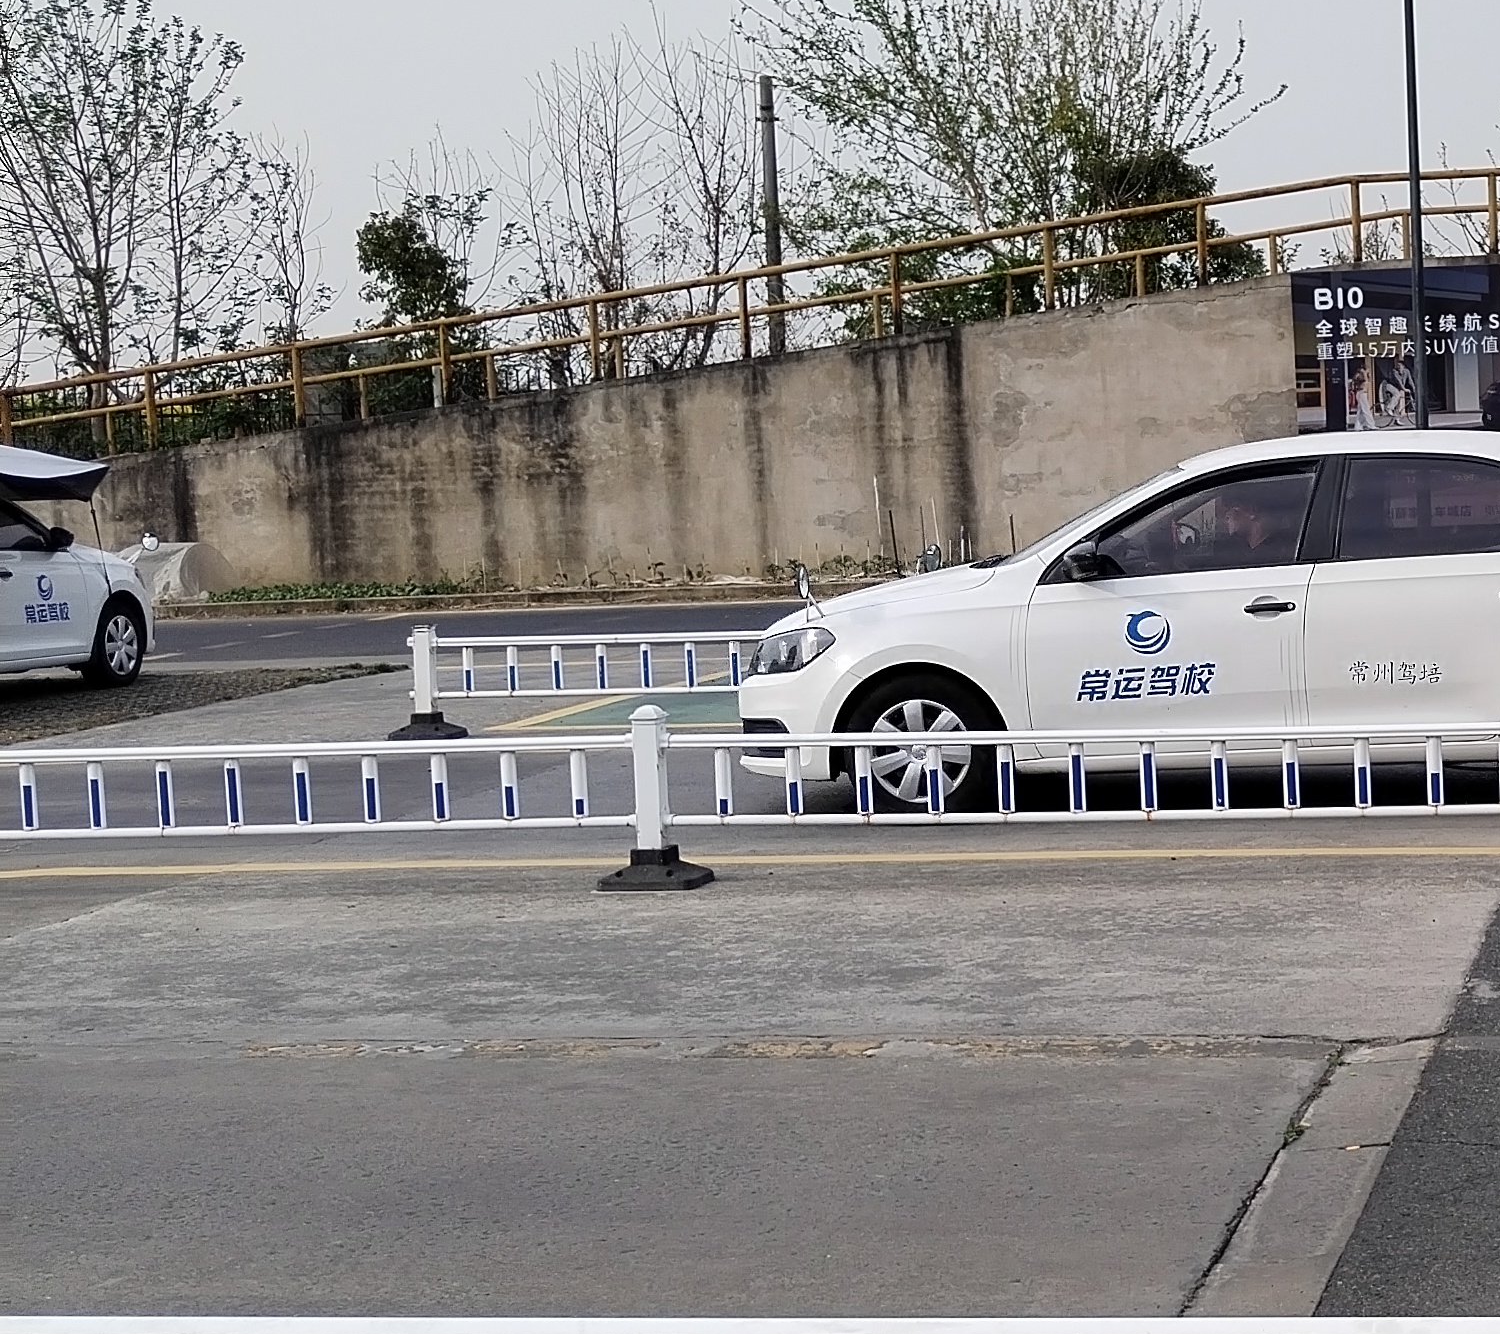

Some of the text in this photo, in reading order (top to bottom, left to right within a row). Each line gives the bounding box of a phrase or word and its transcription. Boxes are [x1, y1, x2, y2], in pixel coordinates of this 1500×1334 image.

[24, 602, 70, 623] 常运驾校
[1077, 662, 1216, 702] 常运驾校
[1349, 660, 1443, 685] 常州驾培
